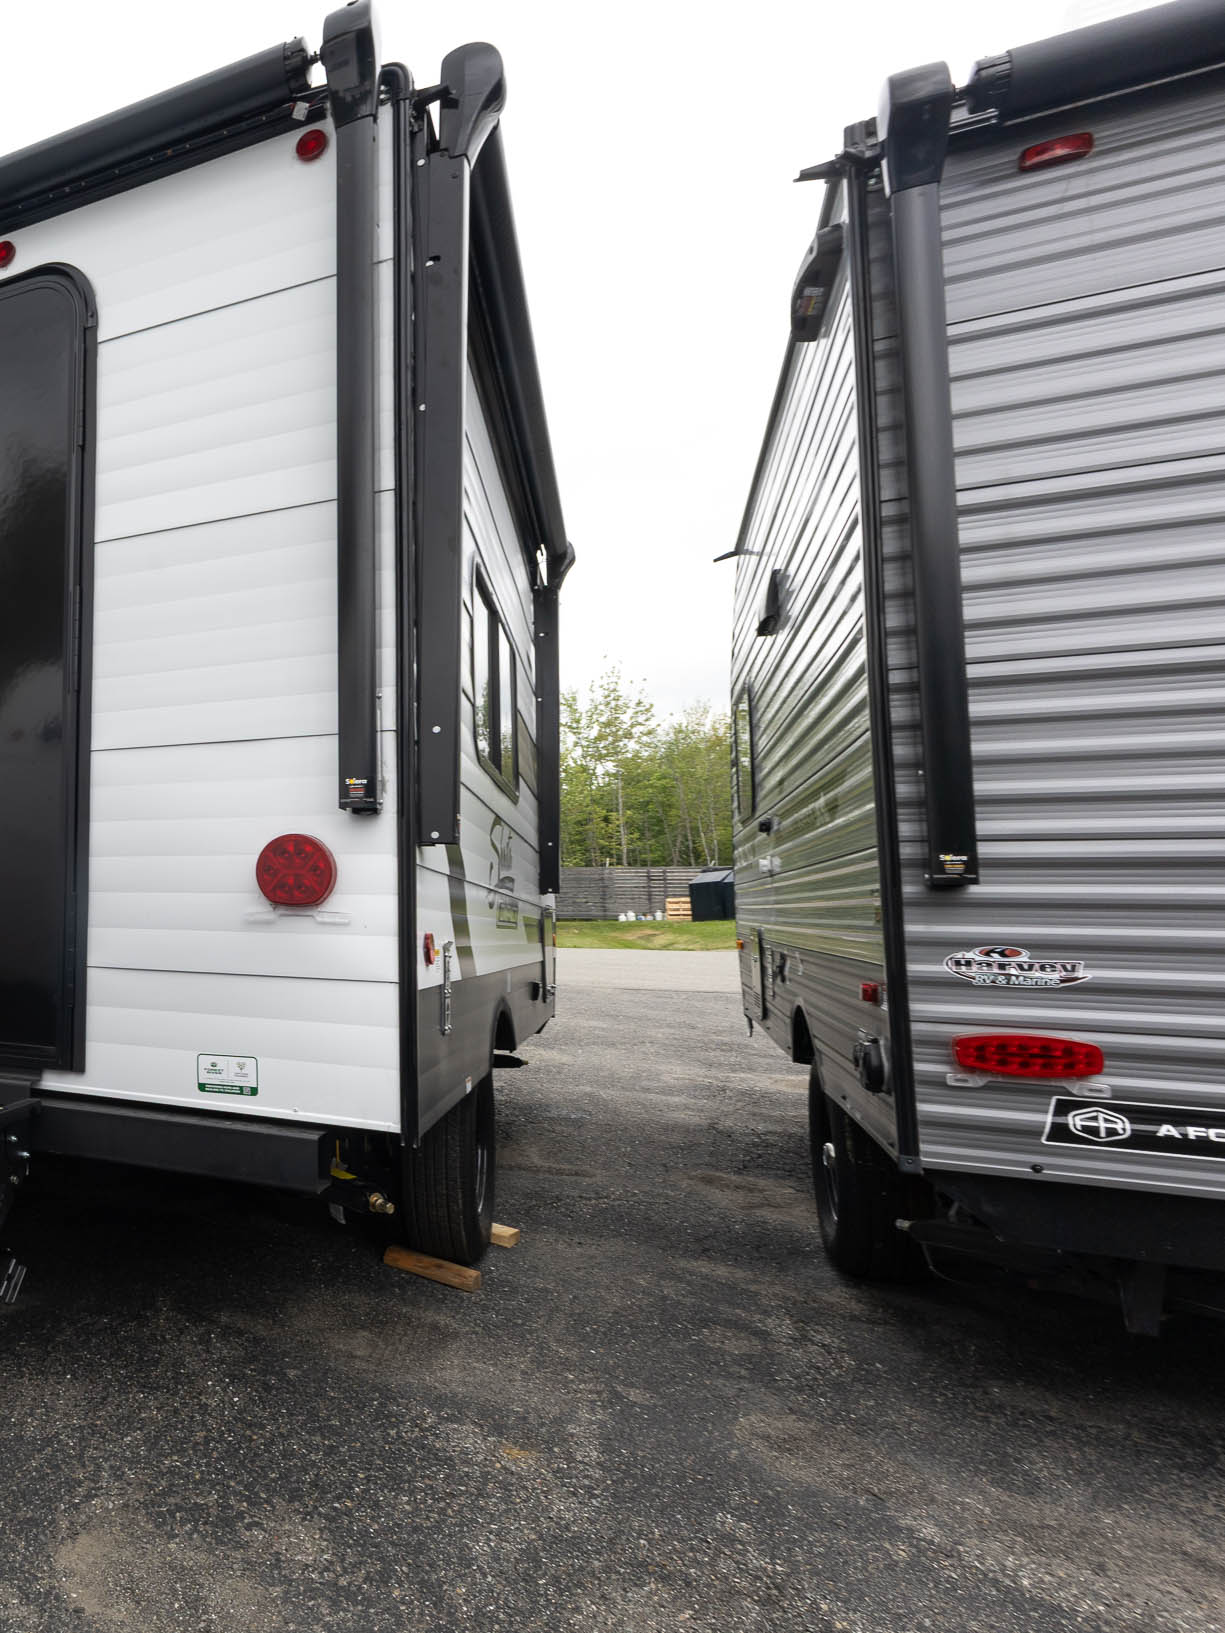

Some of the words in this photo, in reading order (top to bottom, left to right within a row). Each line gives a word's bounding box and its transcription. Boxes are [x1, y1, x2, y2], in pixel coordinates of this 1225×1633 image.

[951, 958, 1081, 977] Harvey
[975, 974, 995, 985] RV
[997, 975, 1009, 986] &
[1010, 976, 1061, 987] Marine
[1156, 1124, 1183, 1139] A
